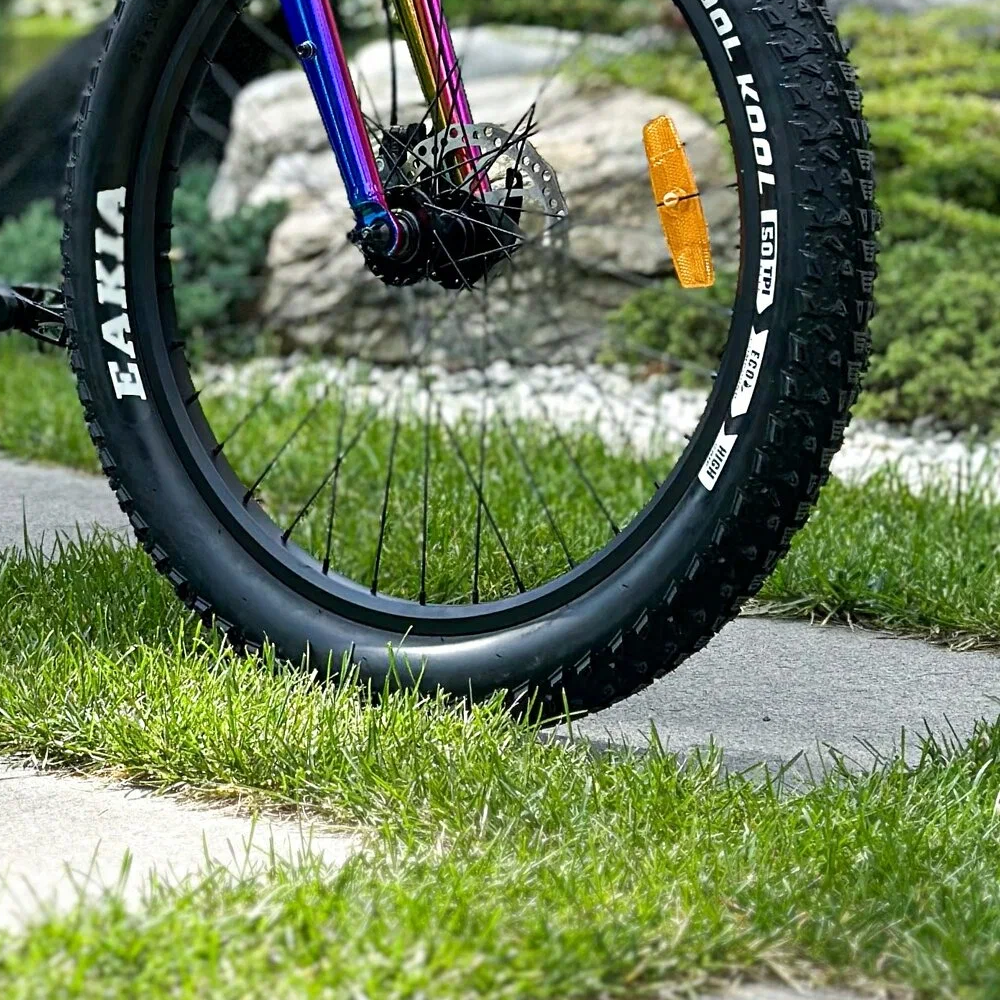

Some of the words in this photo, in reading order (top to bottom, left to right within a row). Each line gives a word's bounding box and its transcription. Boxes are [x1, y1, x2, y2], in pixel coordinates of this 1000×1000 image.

[736, 73, 776, 195] KOOL
[760, 225, 775, 257] 50
[95, 186, 147, 400] EAKIA
[761, 265, 773, 296] TPI
[746, 349, 760, 381] ECO
[705, 444, 727, 480] HIGH
